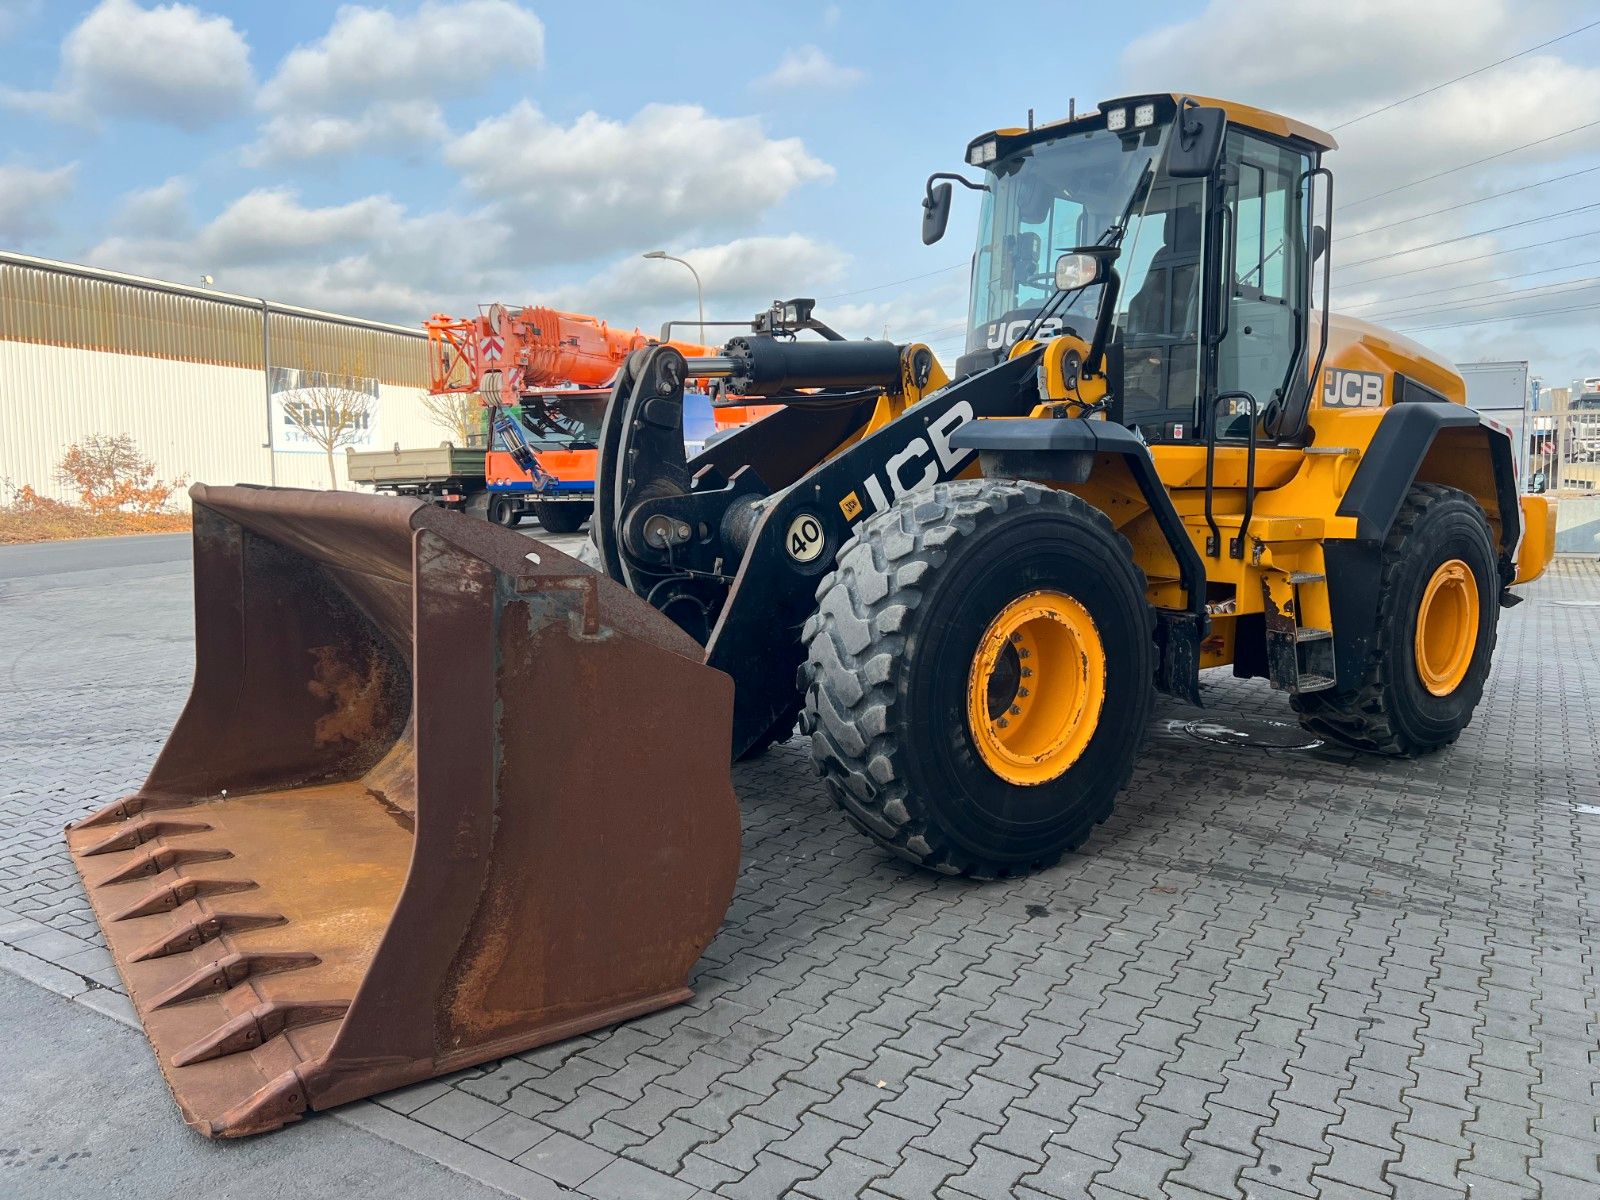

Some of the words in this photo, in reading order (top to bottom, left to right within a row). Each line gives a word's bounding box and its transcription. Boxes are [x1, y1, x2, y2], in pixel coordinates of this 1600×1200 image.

[987, 318, 1063, 349] JCB
[1324, 371, 1384, 406] JCB
[852, 400, 974, 537] JCB
[792, 520, 819, 555] 40
